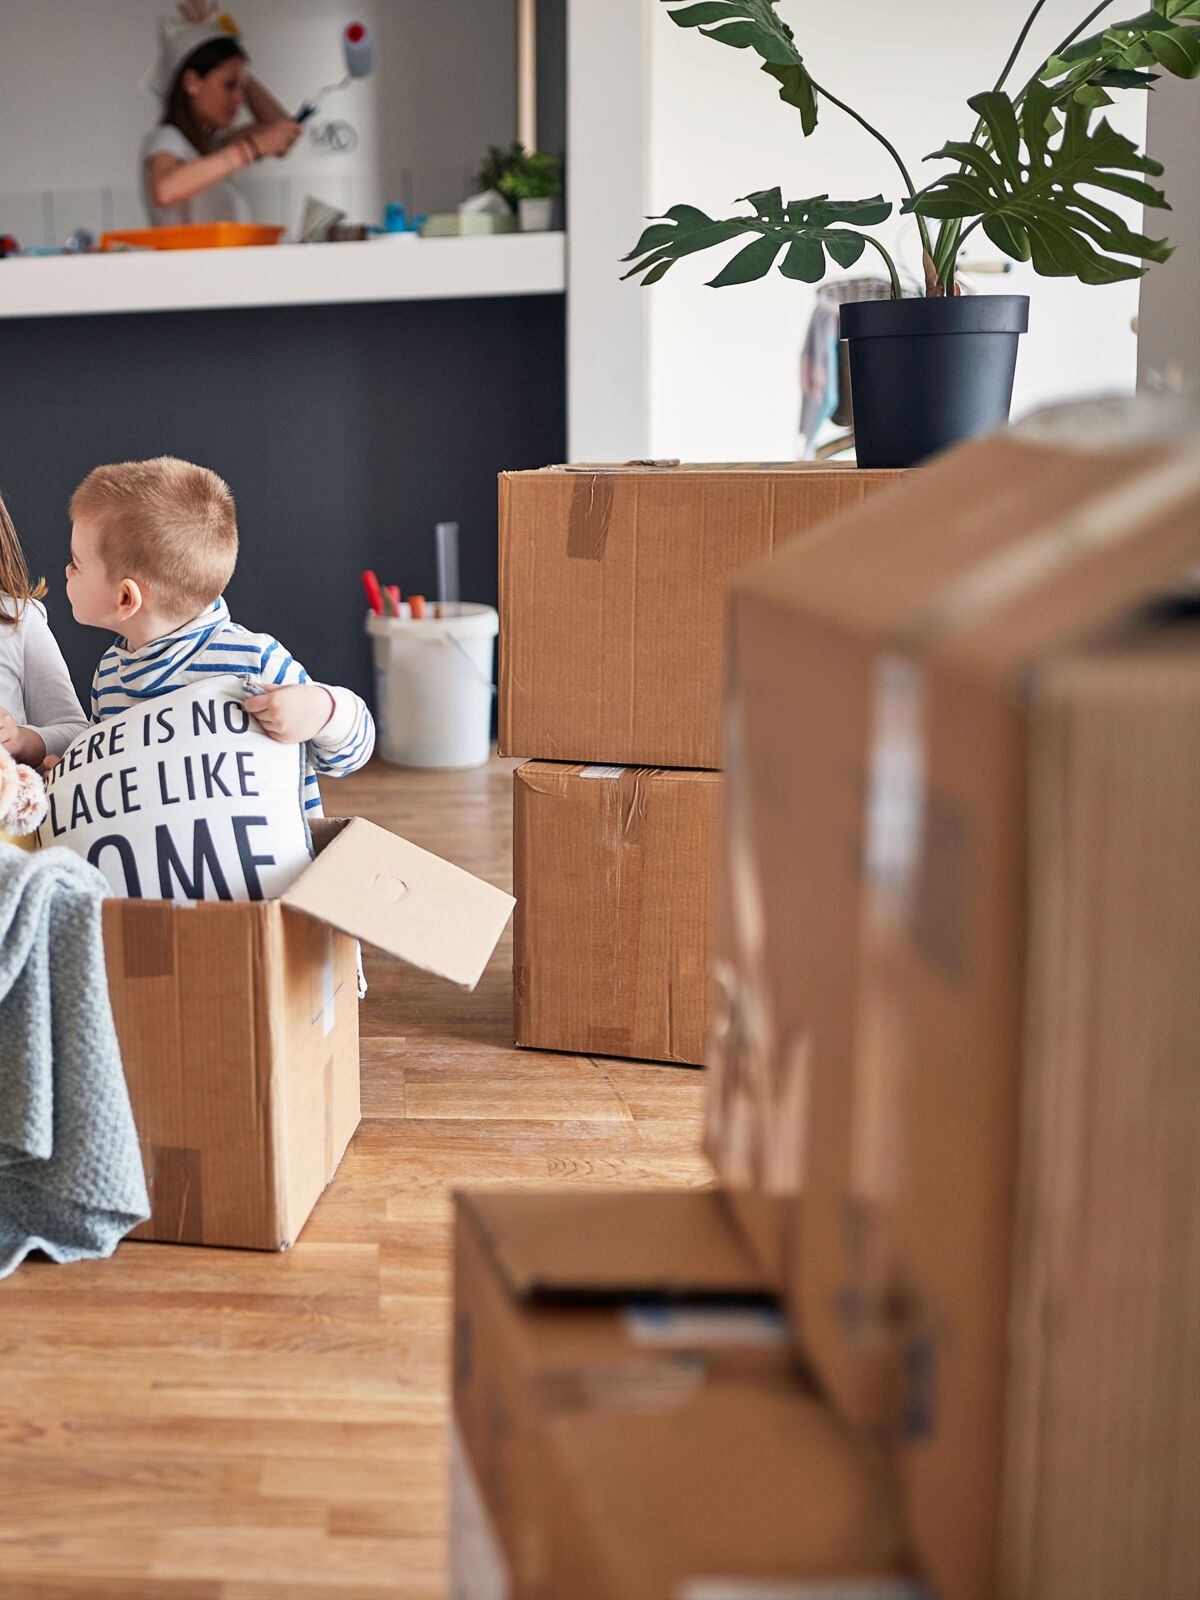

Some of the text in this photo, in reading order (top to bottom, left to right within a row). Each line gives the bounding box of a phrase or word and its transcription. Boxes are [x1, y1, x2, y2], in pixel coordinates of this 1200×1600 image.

[44, 699, 250, 792] HERE IS NO
[37, 751, 260, 848] LACE LIKE
[86, 815, 276, 901] OME
